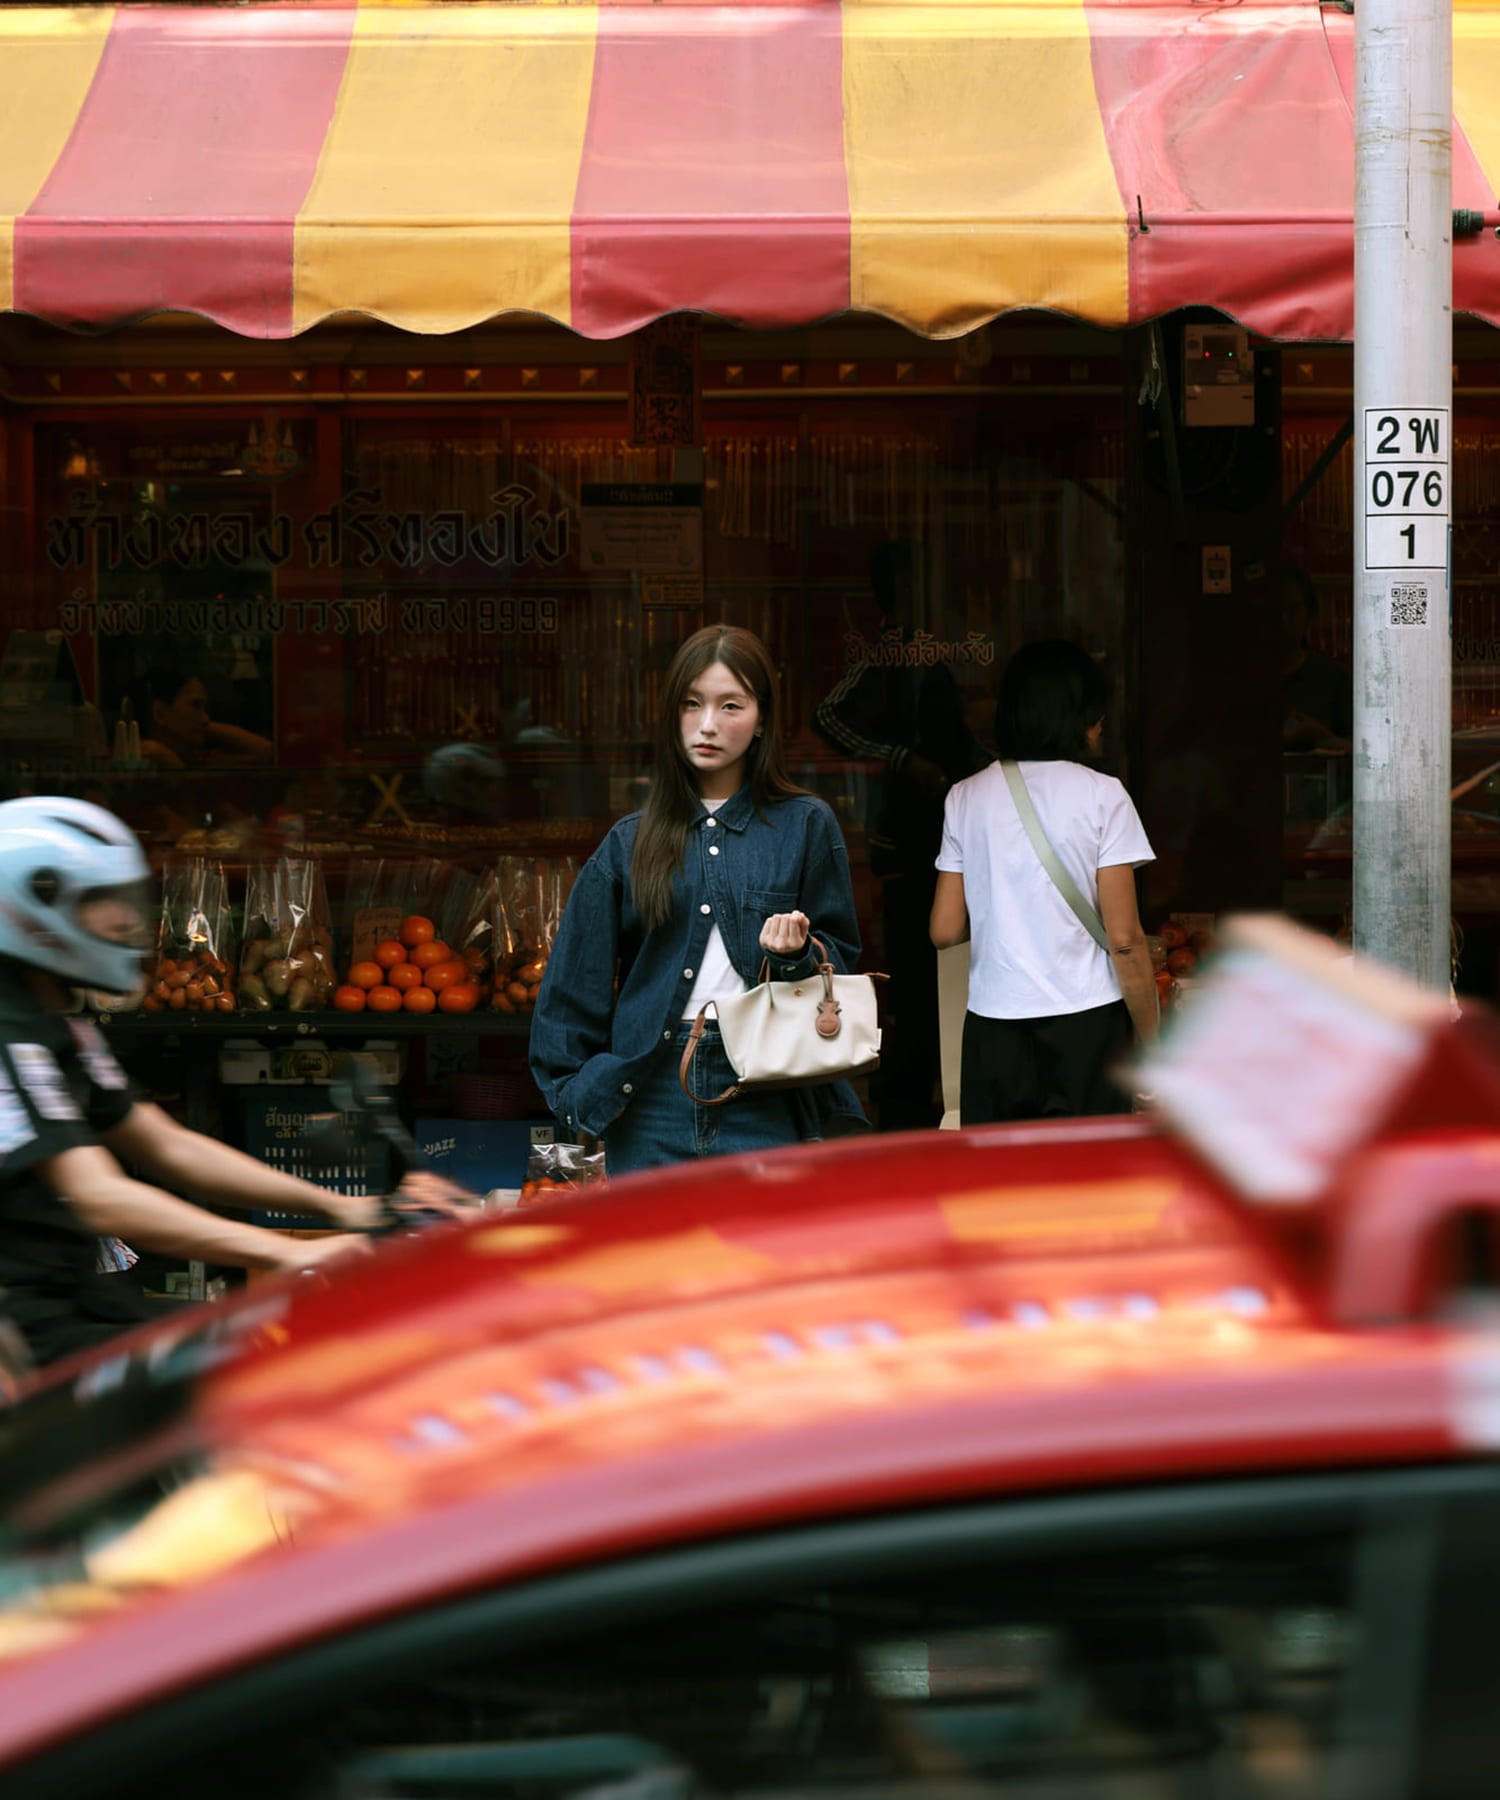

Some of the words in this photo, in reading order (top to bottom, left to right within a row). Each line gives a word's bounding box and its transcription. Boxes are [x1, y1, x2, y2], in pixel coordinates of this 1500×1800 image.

[1372, 470, 1443, 507] 076
[1400, 523, 1416, 559] 1
[478, 597, 559, 635] 9999
